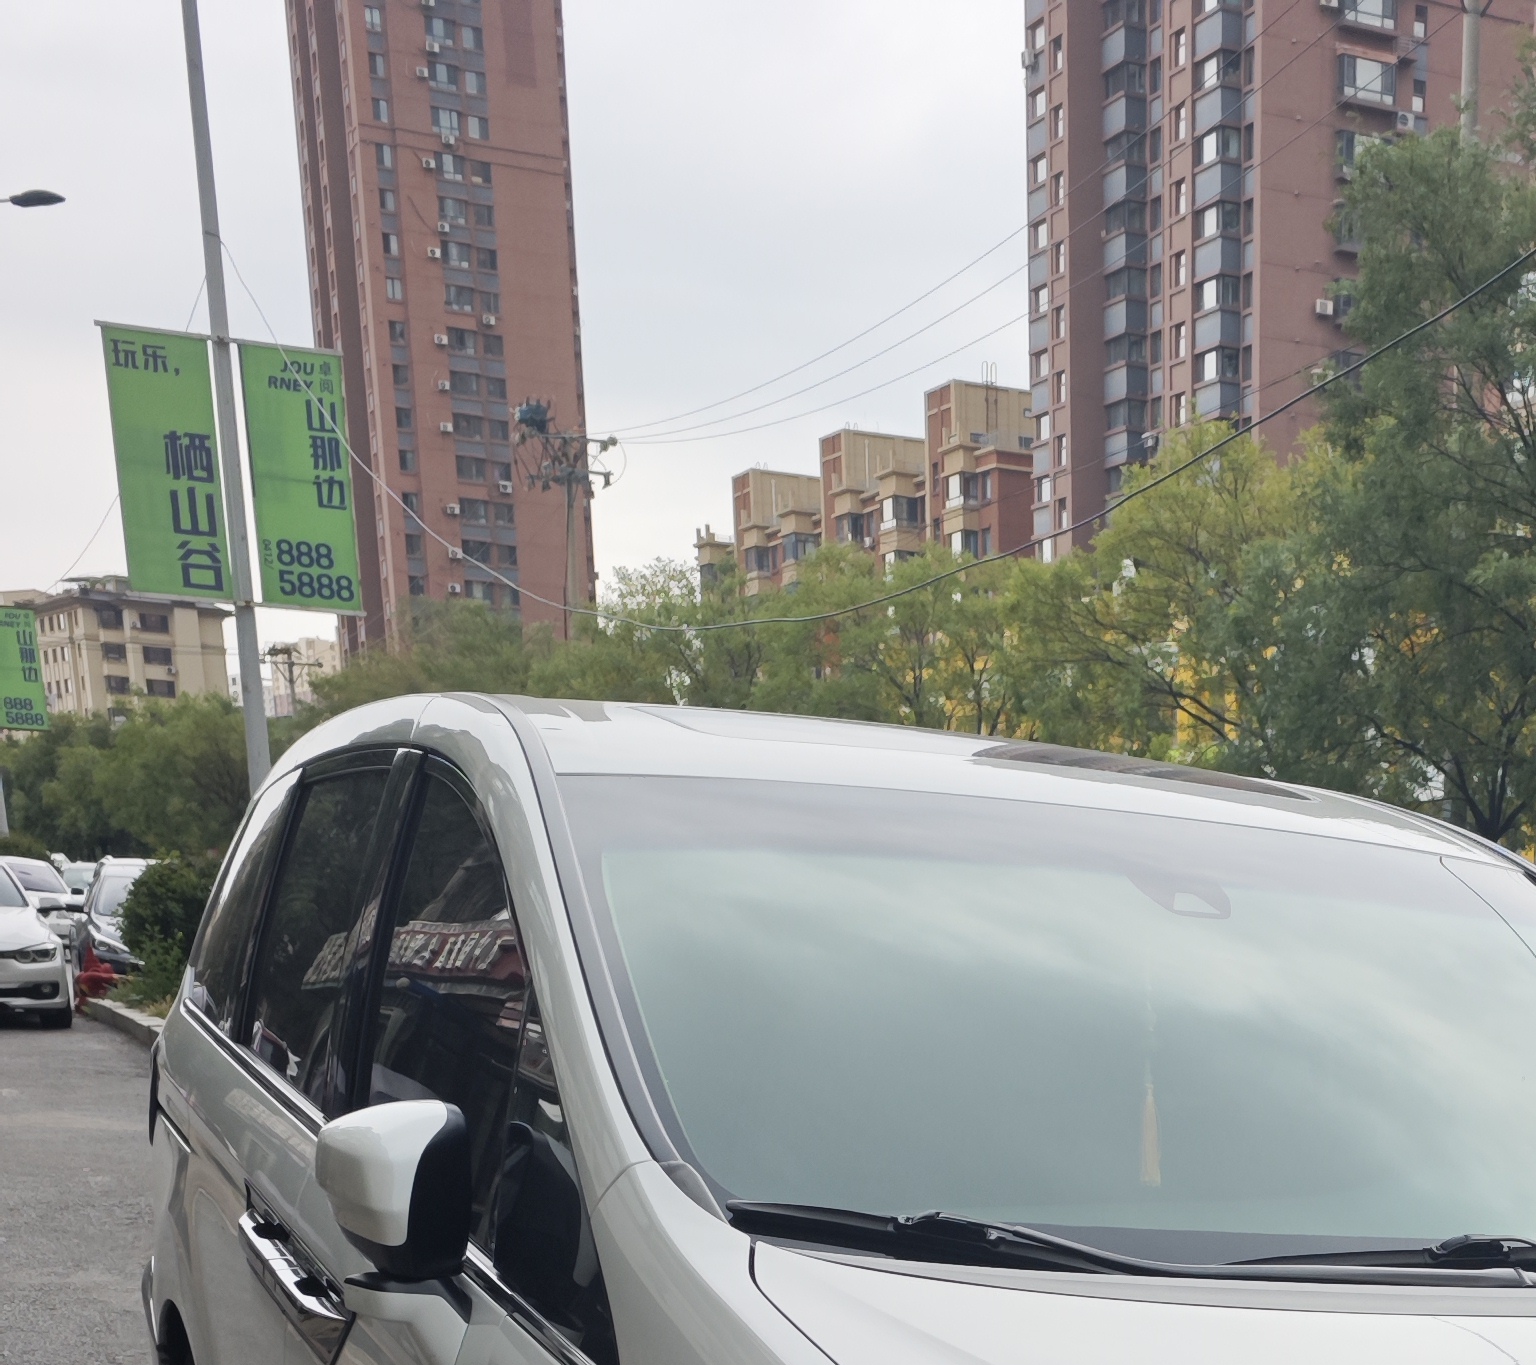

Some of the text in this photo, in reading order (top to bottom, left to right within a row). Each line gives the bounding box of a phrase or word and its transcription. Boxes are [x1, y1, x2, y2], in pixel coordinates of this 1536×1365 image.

[280, 360, 315, 376] JOU
[268, 375, 313, 393] RNEY
[305, 397, 347, 511] 山那边
[163, 430, 224, 591] 栖山谷
[276, 538, 335, 570] 888
[278, 569, 355, 602] 5888
[4, 696, 33, 711] 888
[5, 711, 45, 727] 5888
